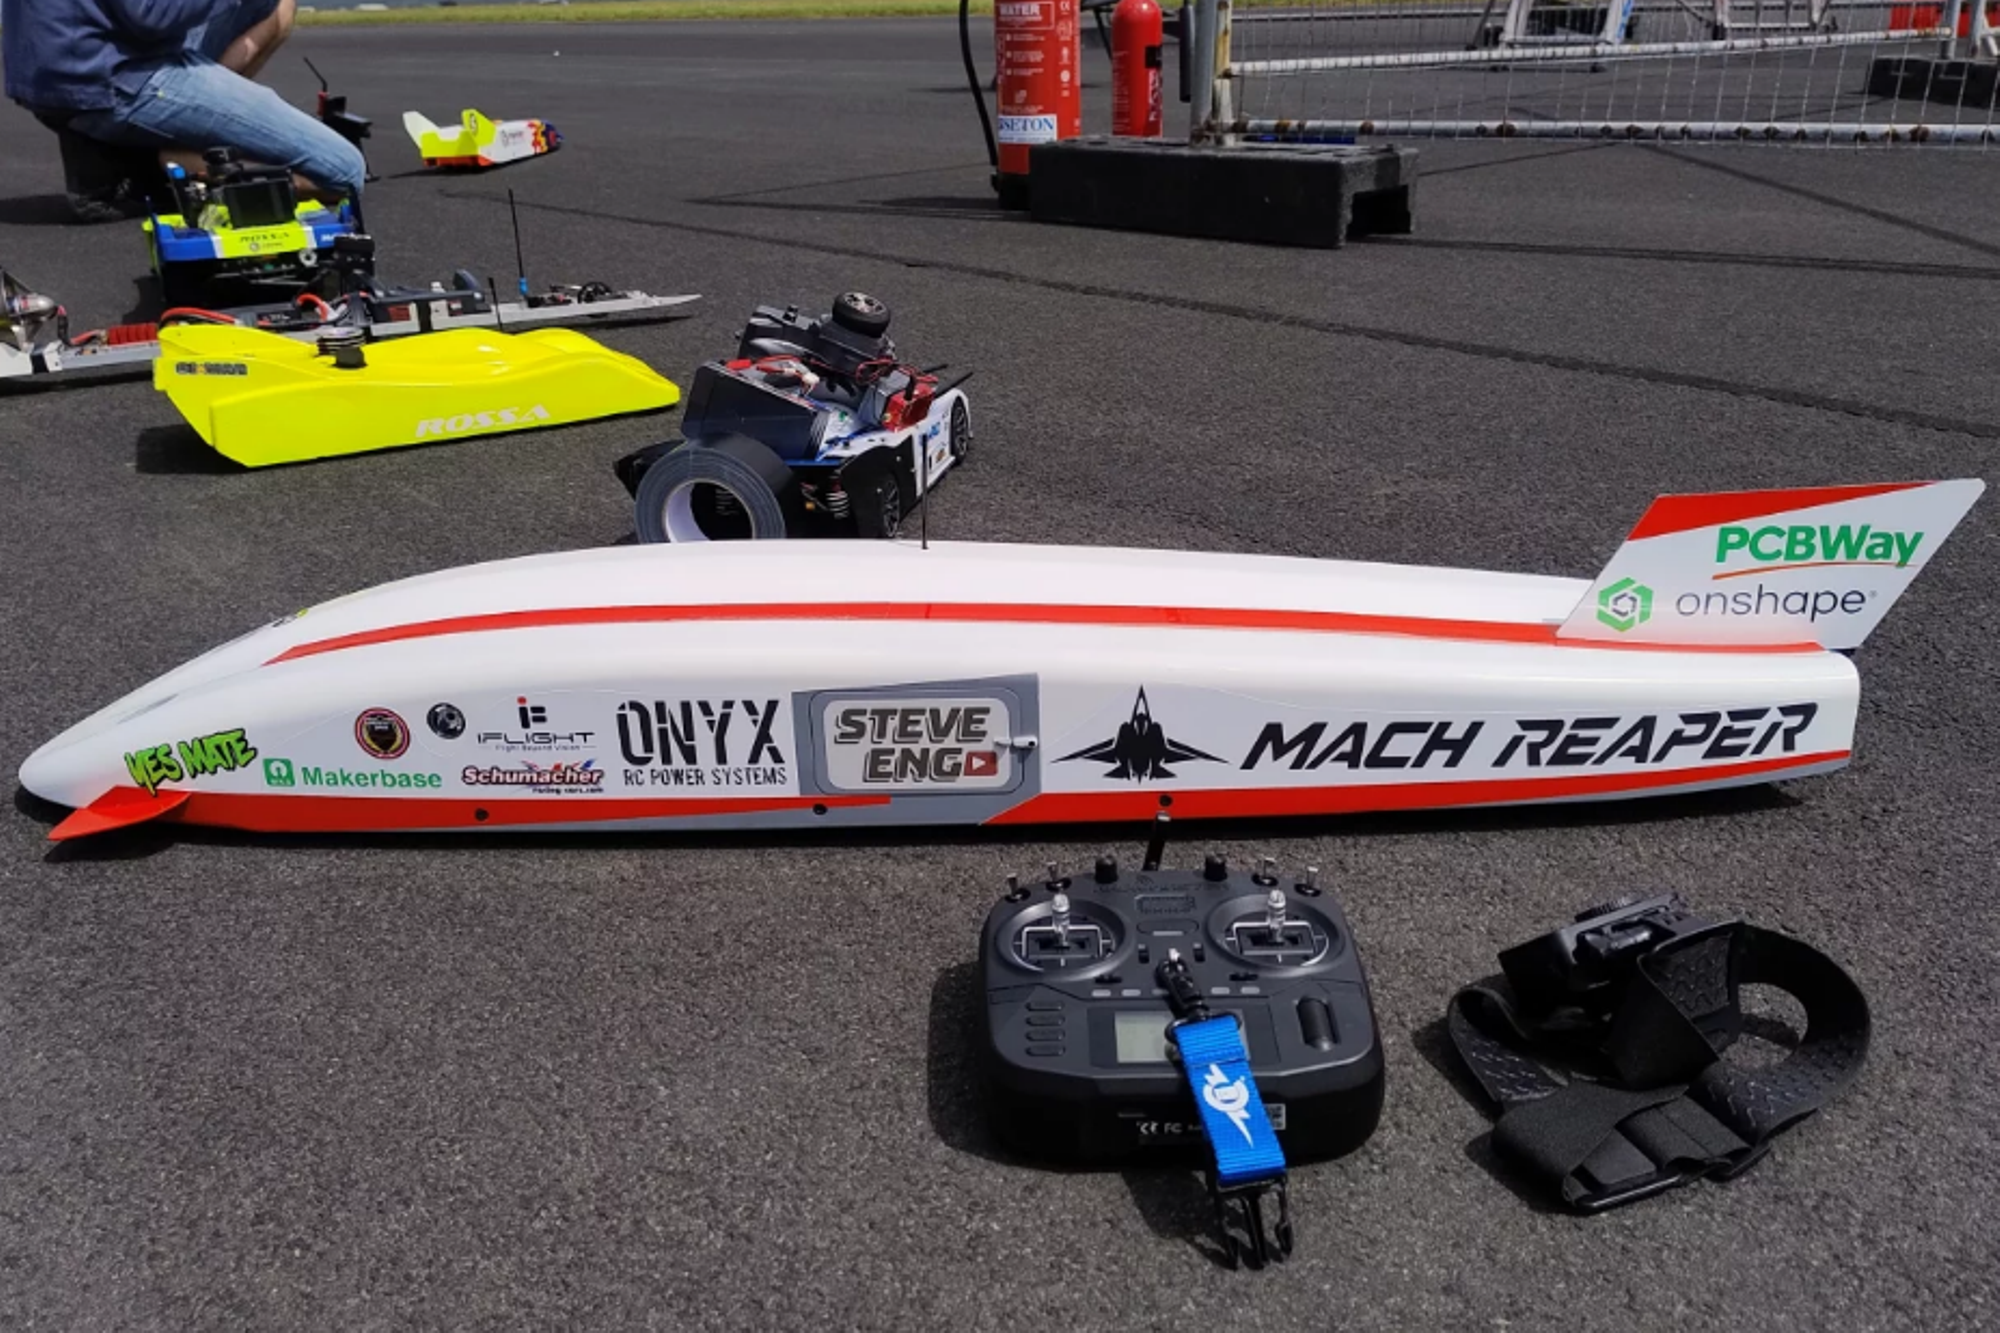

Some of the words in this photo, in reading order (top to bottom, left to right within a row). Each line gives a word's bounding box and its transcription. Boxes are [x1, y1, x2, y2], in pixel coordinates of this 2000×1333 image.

[999, 117, 1053, 131] SETON
[415, 404, 550, 438] ROSSA
[1715, 524, 1924, 568] PCBWay
[616, 700, 785, 766] ONYX
[834, 707, 991, 744] STEVE
[1240, 721, 1484, 770] MACH
[1491, 702, 1818, 768] REAPER
[124, 743, 185, 796] YES
[177, 728, 257, 779] MATE
[302, 766, 443, 788] Makerbase
[461, 764, 605, 786] Schumacher
[624, 768, 644, 786] RC
[650, 768, 705, 785] POWER
[712, 767, 787, 785] SYSTEMS
[862, 748, 963, 782] ENG
